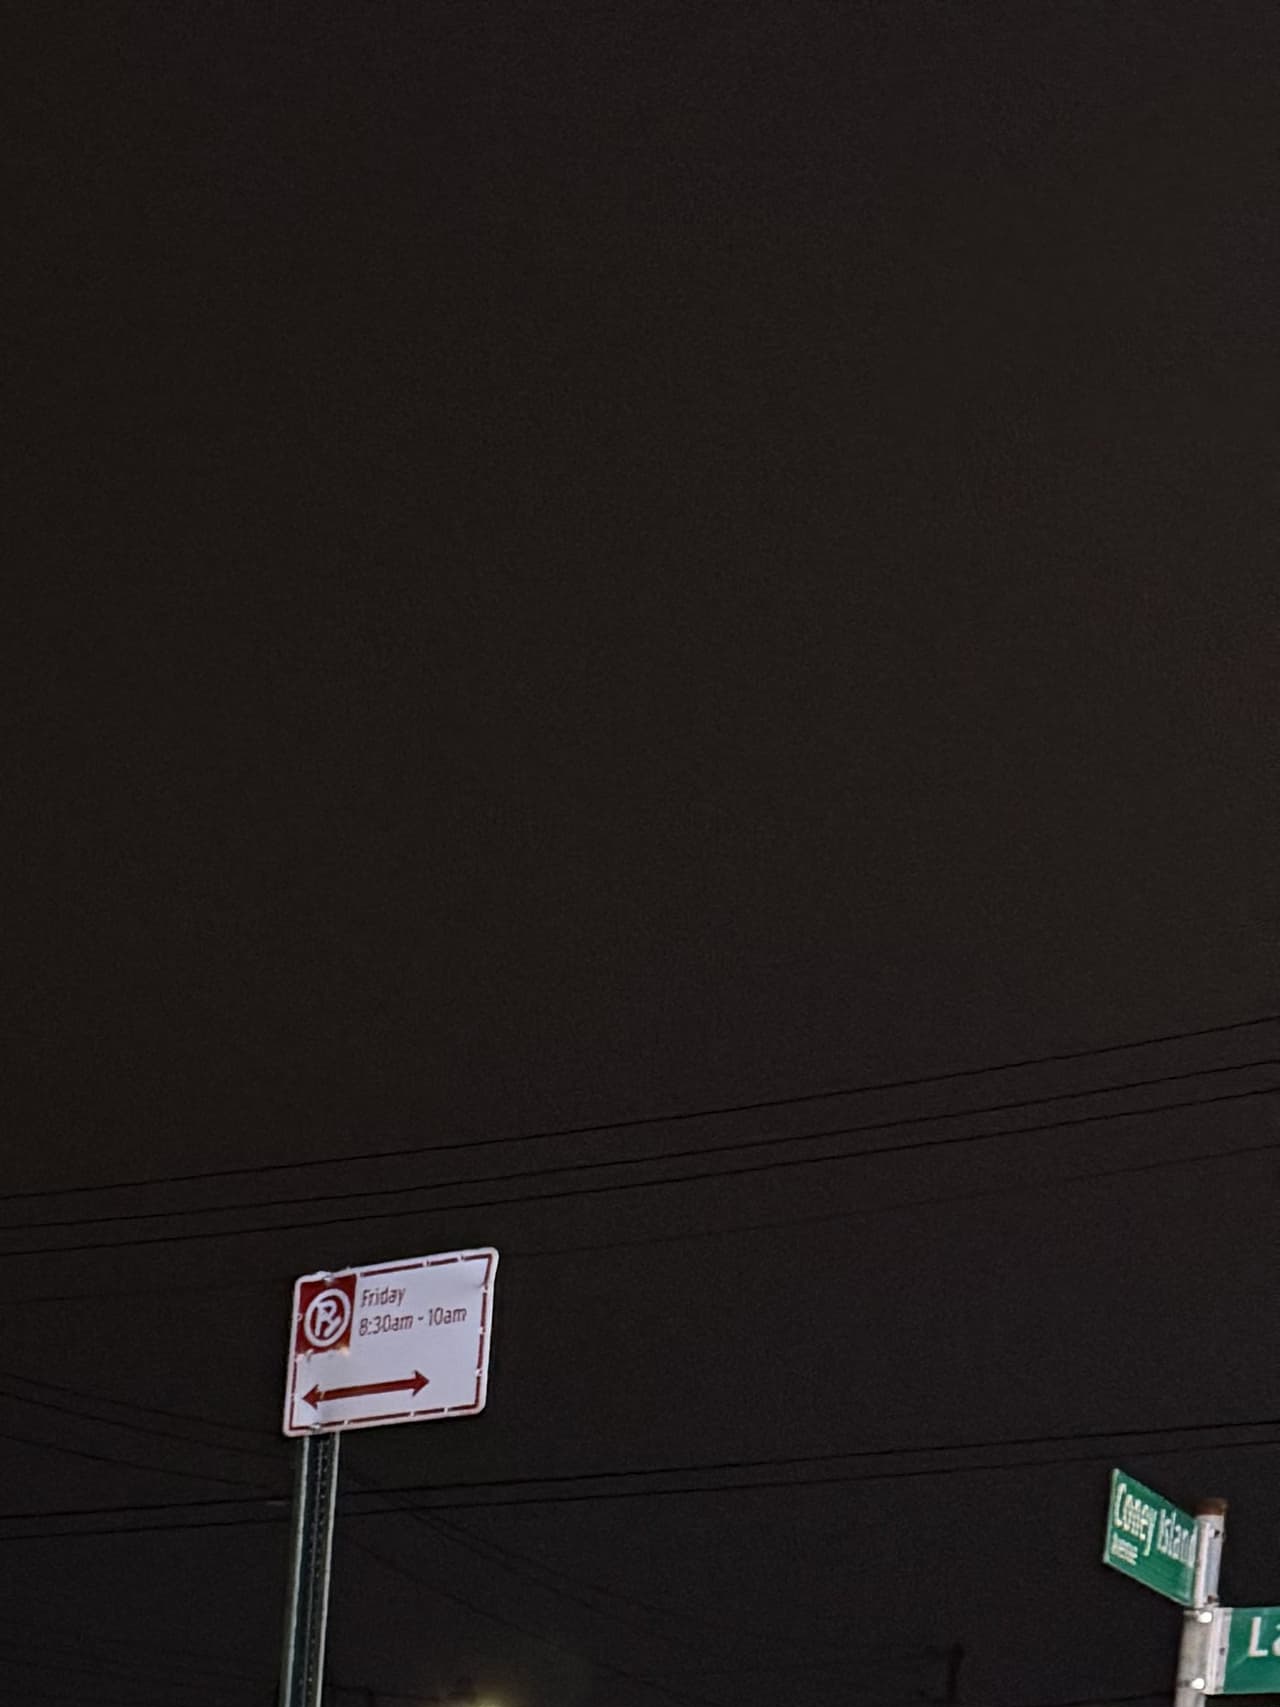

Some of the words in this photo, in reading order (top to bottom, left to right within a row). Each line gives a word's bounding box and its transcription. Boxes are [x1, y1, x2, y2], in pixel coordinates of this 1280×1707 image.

[359, 1285, 406, 1308] Friday
[358, 1315, 414, 1338] 8:30am
[427, 1305, 468, 1327] 10am
[1113, 1482, 1158, 1557] Coney
[1156, 1507, 1198, 1569] Island
